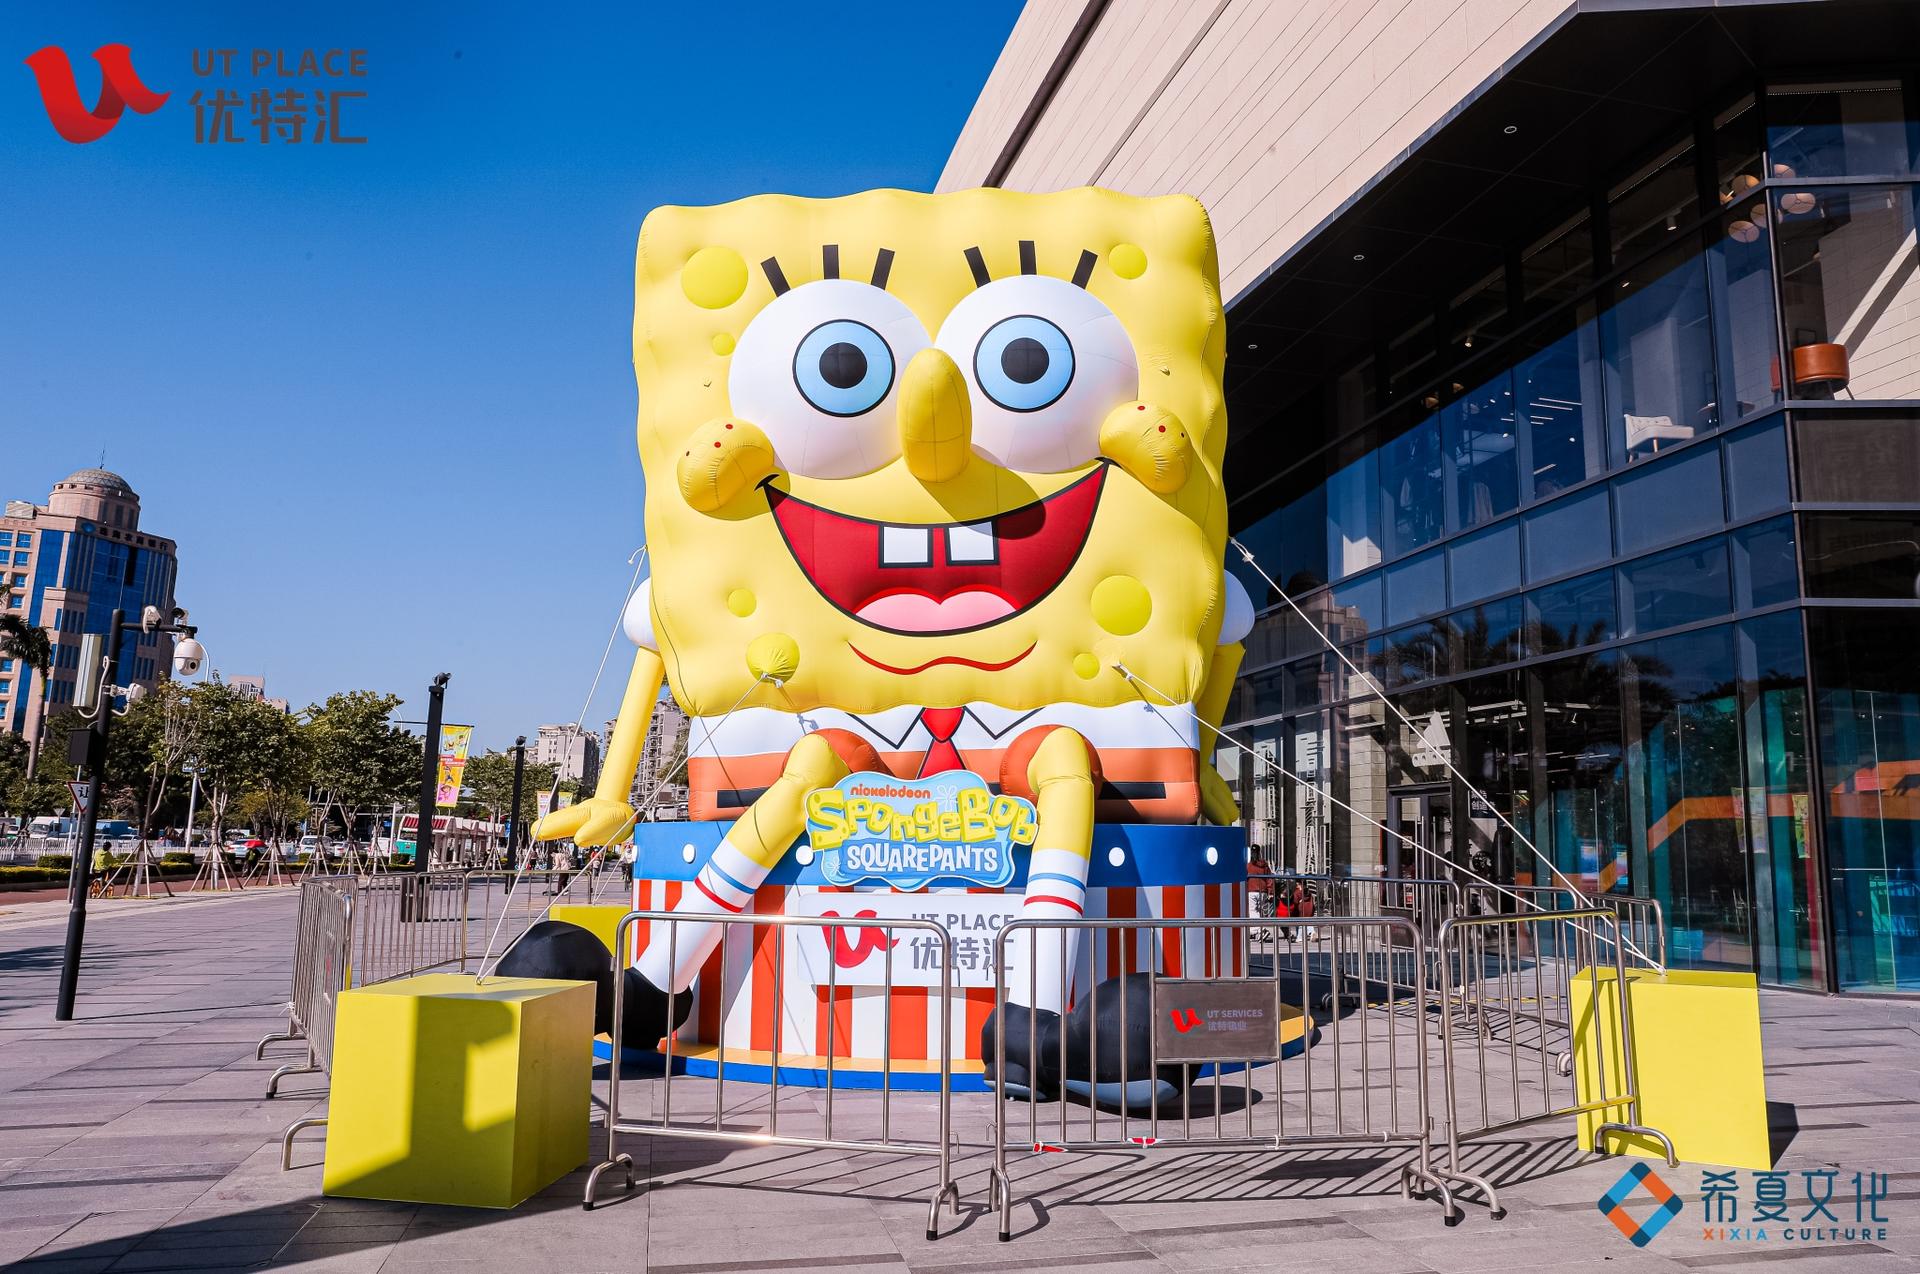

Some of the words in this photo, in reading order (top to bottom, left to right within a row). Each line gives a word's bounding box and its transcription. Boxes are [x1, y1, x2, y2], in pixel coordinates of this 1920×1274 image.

[850, 784, 931, 799] nickelodeon
[847, 842, 999, 872] SQUAREPANTS
[1207, 1010, 1220, 1018] UT
[1221, 1009, 1263, 1018] SERVICES
